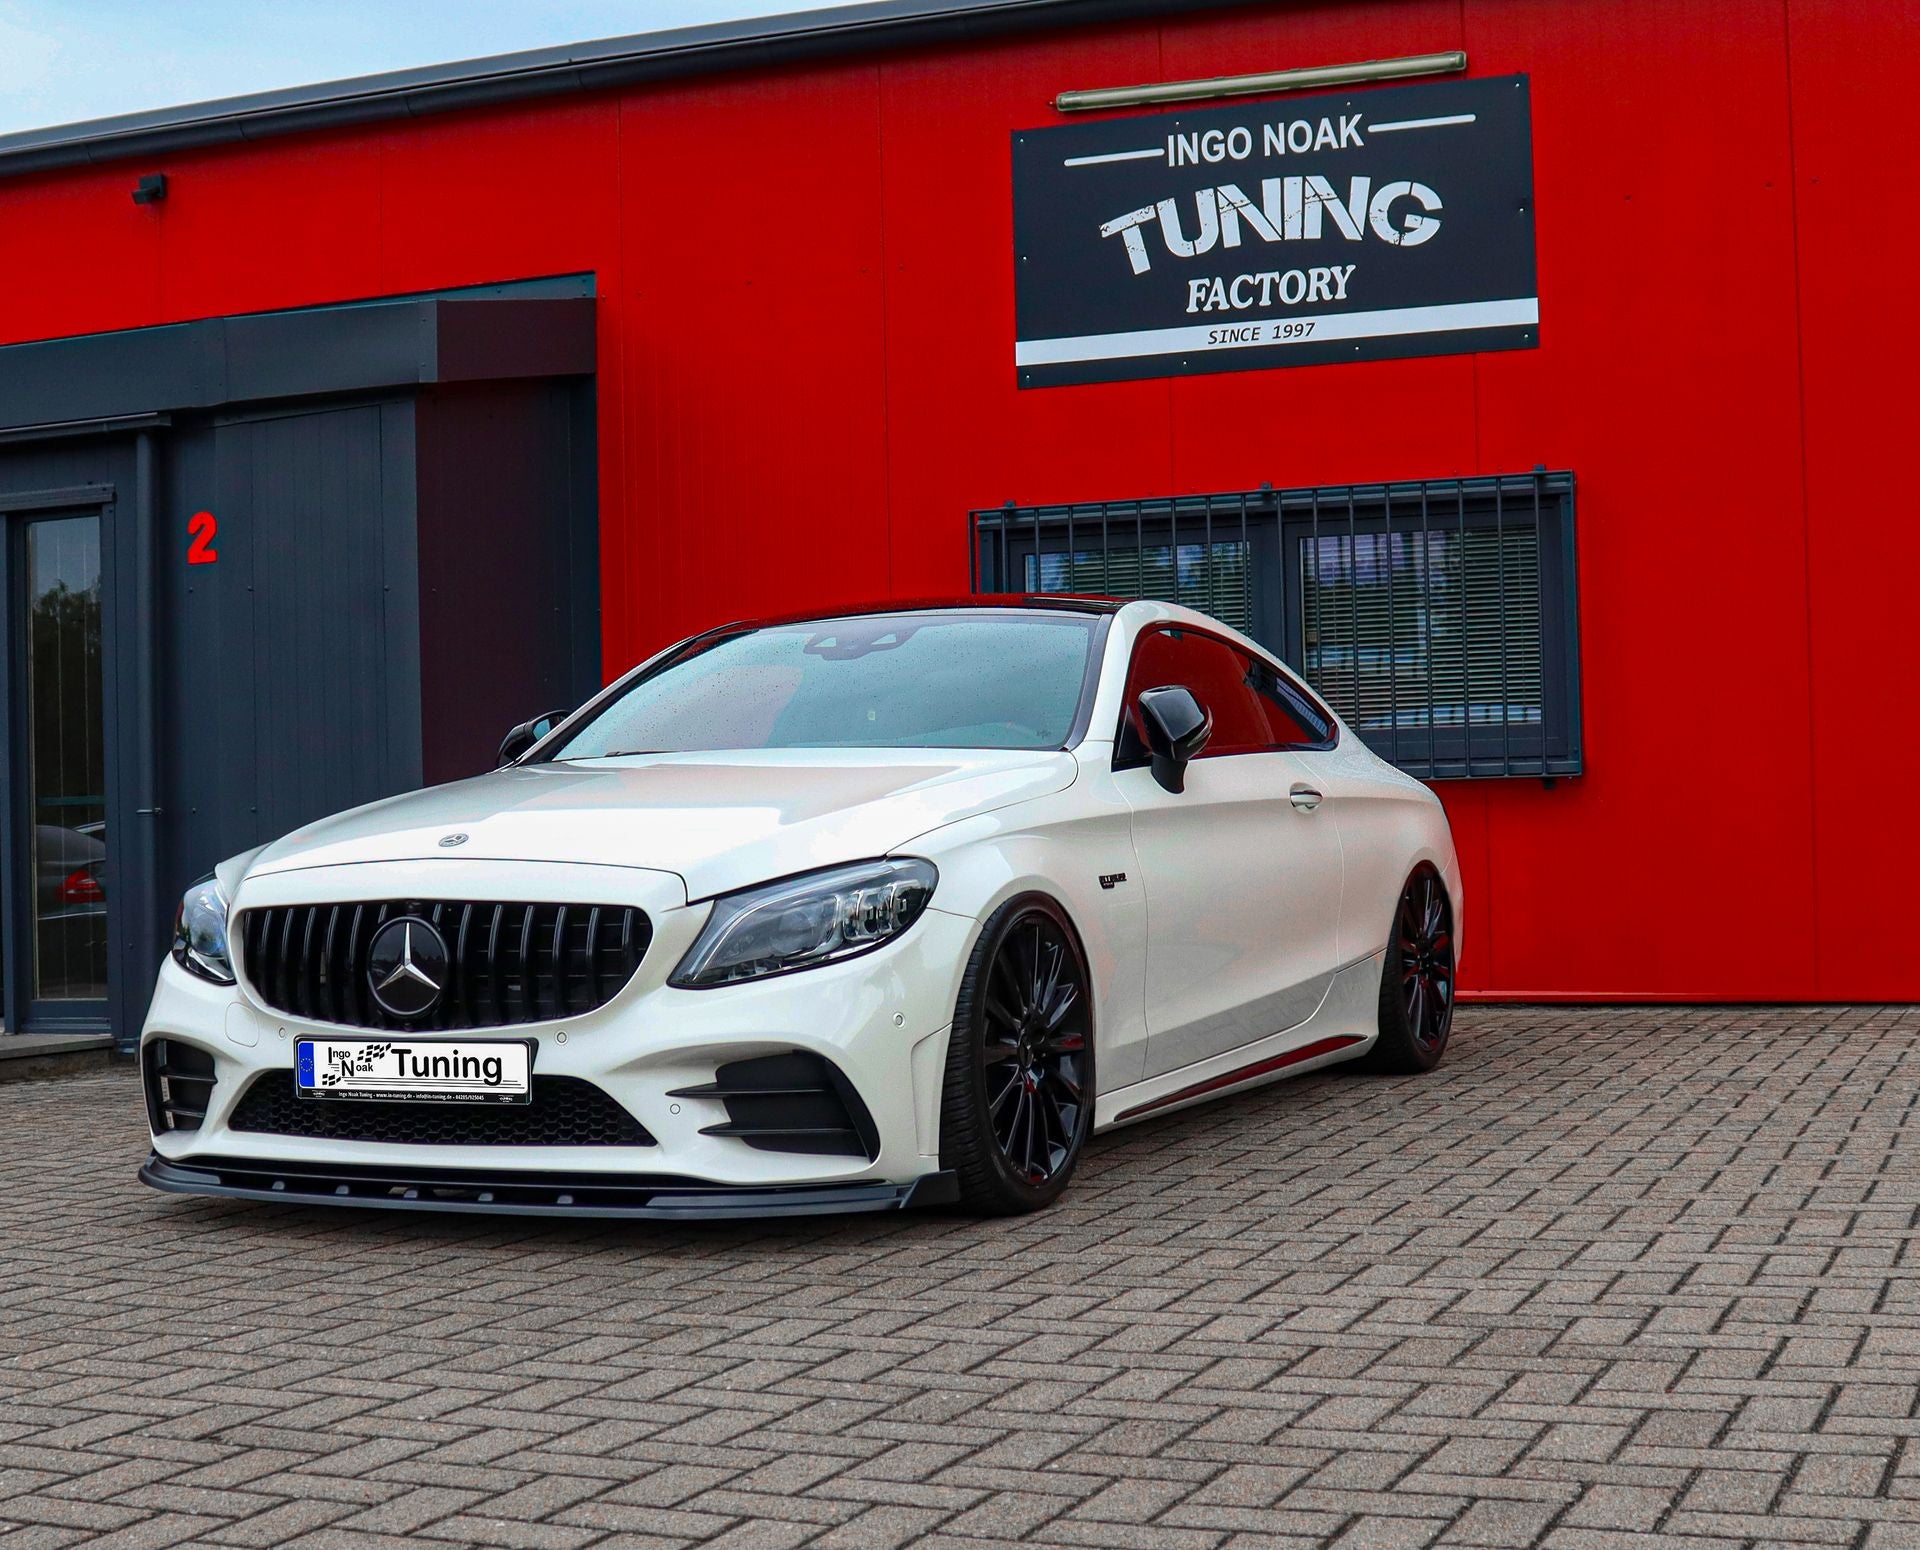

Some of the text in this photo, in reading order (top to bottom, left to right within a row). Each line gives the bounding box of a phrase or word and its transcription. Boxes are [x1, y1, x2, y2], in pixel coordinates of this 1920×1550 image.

[1168, 114, 1365, 167] INGO NOAK
[1100, 175, 1444, 276] TUNING
[1186, 265, 1356, 313] FACTORY
[1207, 322, 1316, 345] SINCE 1997
[187, 511, 218, 565] 2
[328, 1046, 351, 1063] Ingo
[342, 1060, 374, 1077] Noak
[391, 1049, 502, 1086] Tuning
